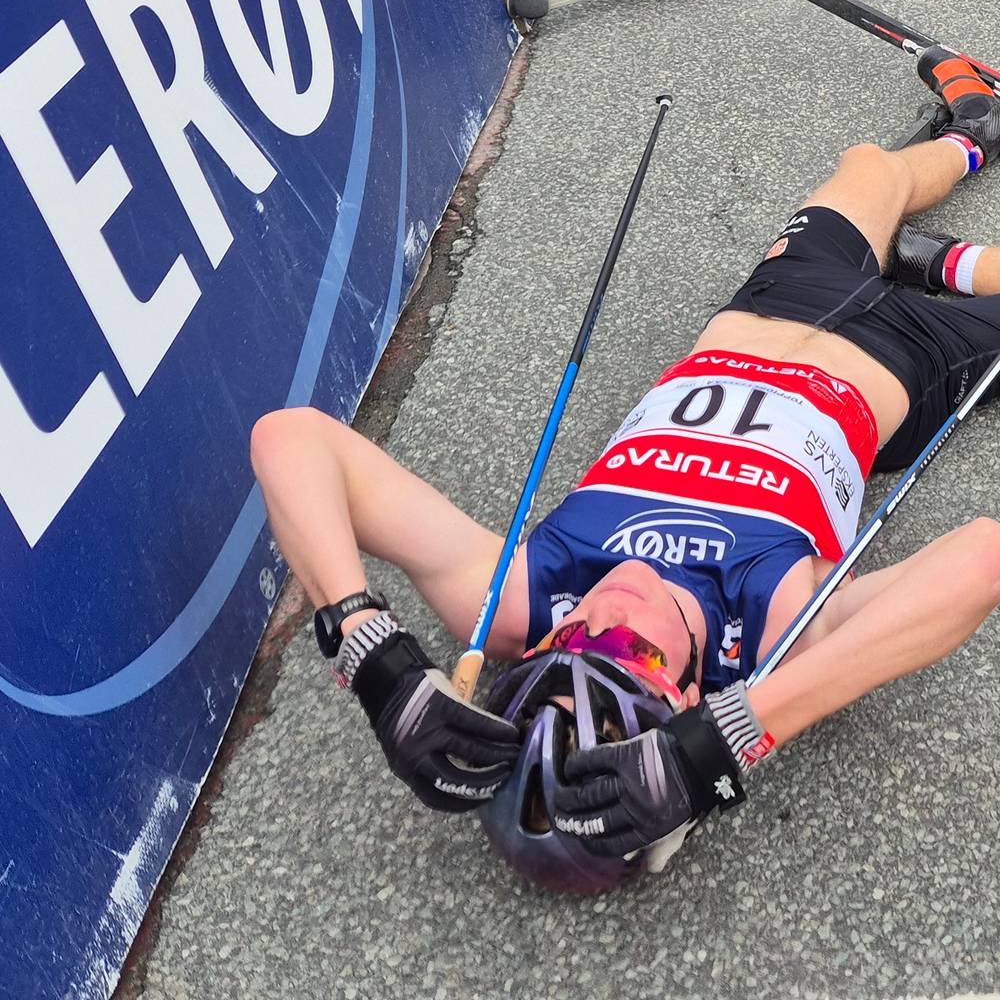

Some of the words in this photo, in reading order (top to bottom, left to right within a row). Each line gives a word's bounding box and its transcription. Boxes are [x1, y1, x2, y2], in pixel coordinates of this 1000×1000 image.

[706, 355, 815, 379] RETURA
[670, 384, 774, 436] 10
[627, 447, 790, 496] RETURA
[804, 441, 838, 489] VVS
[806, 429, 856, 500] EKSPERTEN
[602, 529, 727, 567] LERØY
